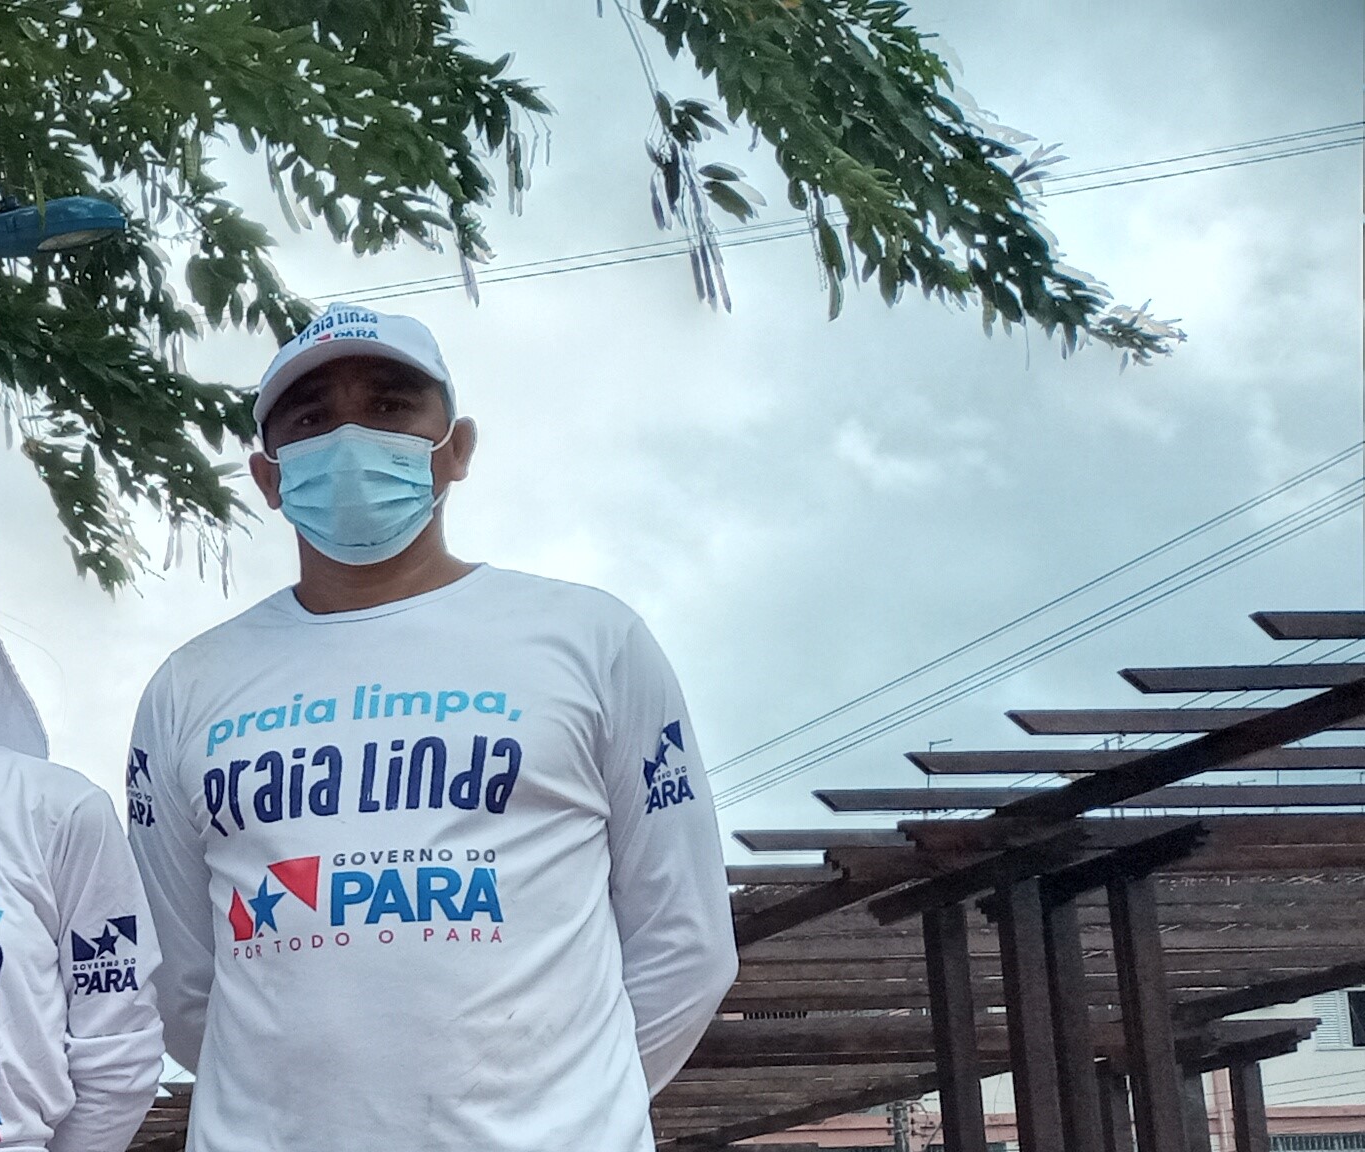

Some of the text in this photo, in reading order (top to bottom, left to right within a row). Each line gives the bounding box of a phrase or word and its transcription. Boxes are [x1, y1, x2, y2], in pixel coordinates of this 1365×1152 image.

[206, 683, 522, 757] praia limpa,
[332, 848, 496, 867] GOVERNO DO
[232, 926, 502, 960] POR TODO O PARÁ
